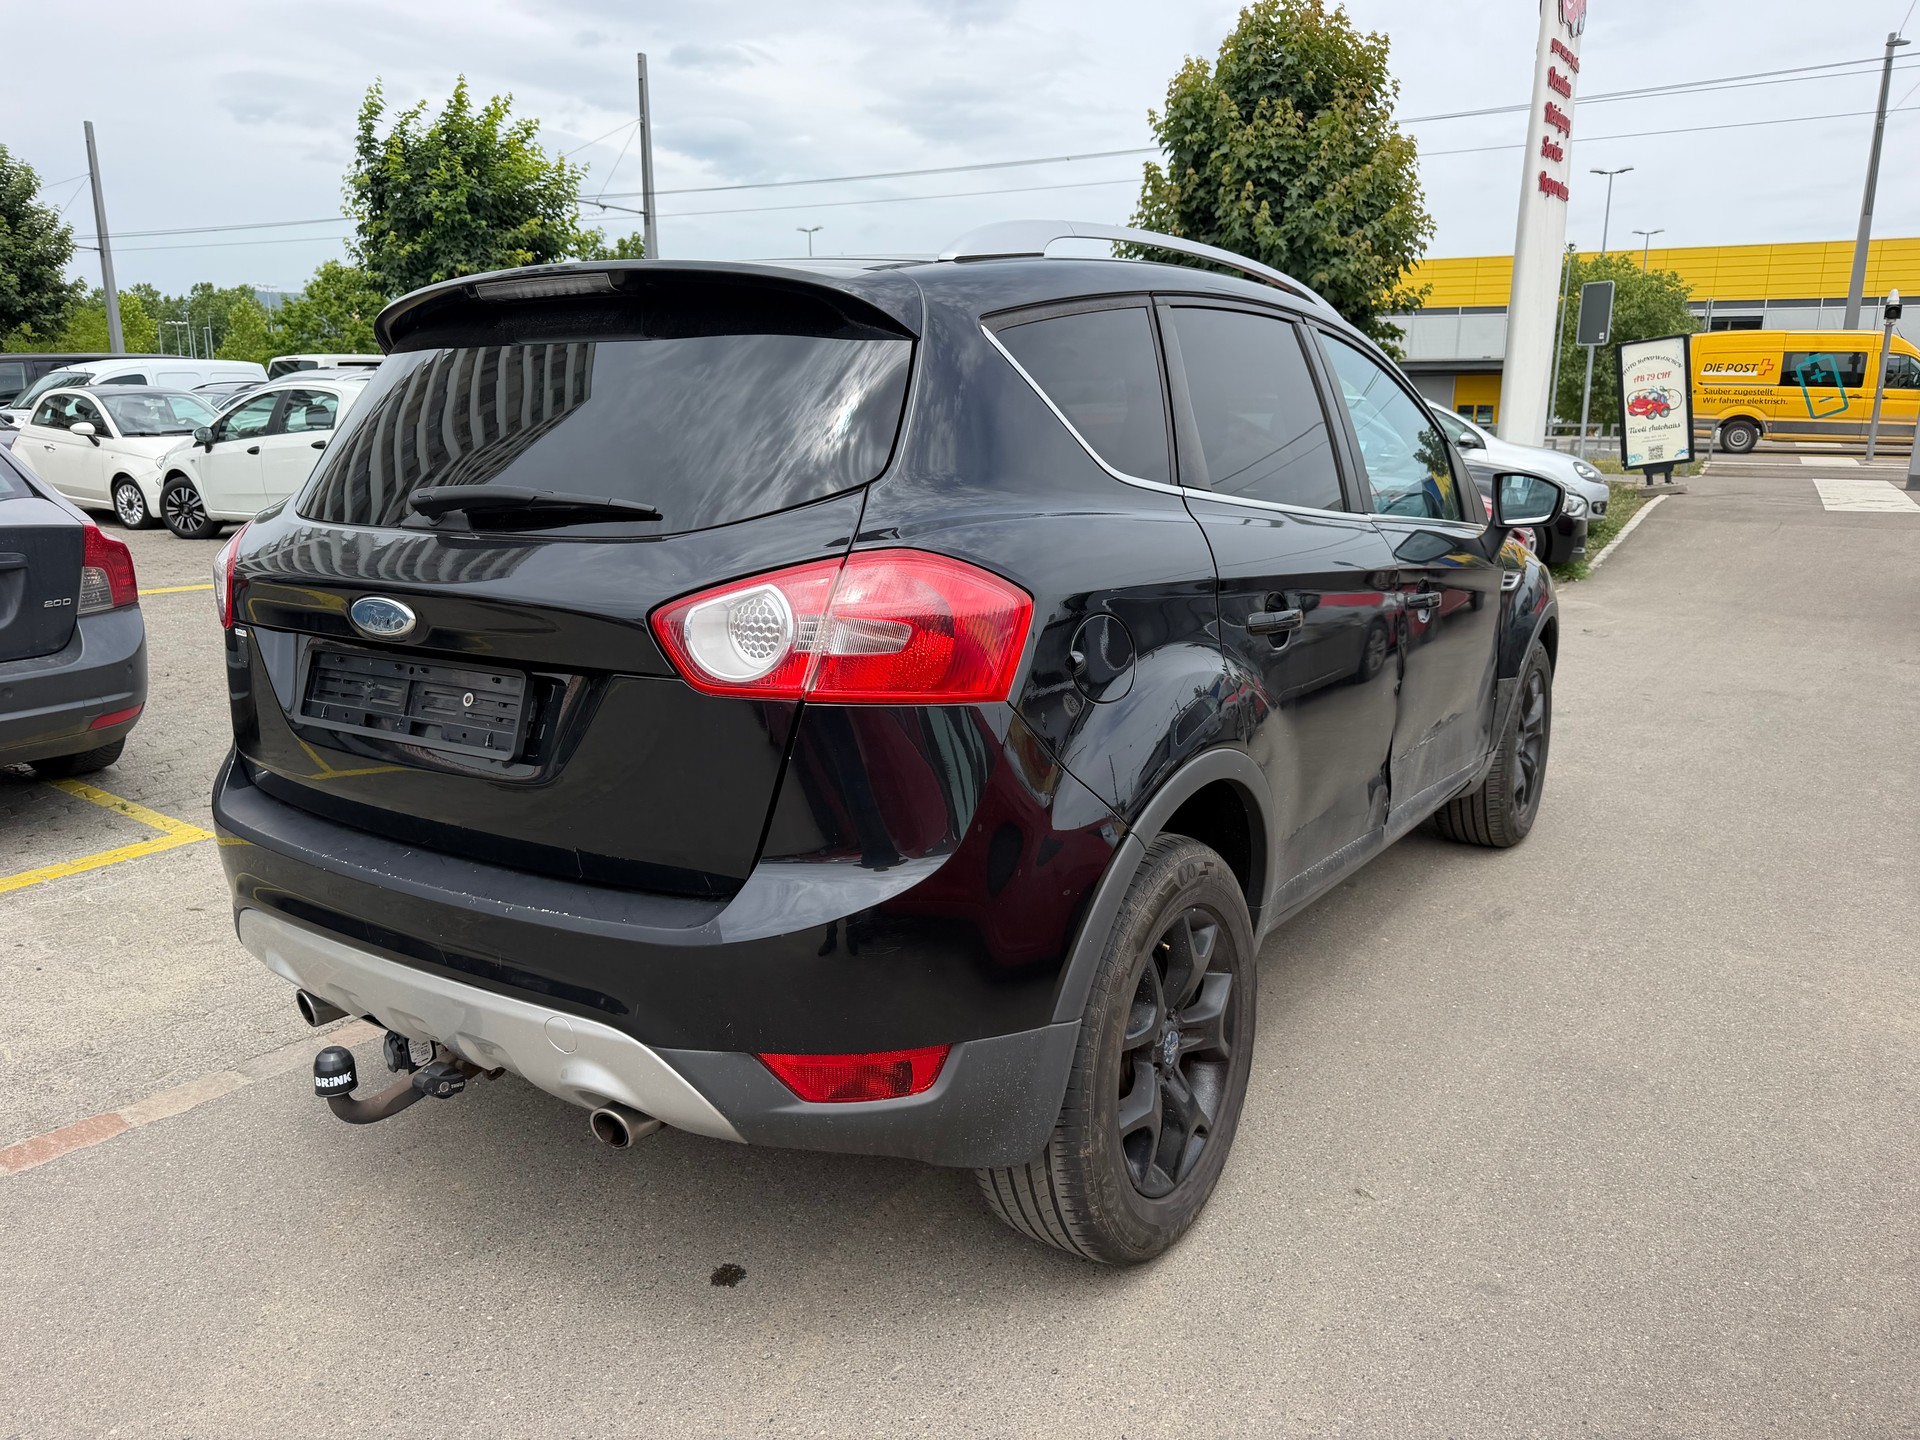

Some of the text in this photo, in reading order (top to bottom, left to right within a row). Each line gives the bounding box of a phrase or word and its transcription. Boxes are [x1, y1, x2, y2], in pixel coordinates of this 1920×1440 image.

[1703, 362, 1759, 373] DIE POST
[1646, 373, 1656, 381] 79
[1656, 370, 1673, 380] CHF
[1703, 387, 1776, 397] Sauber zugestellt.
[1718, 397, 1745, 405] fahren
[1747, 397, 1788, 405] elektrisch.
